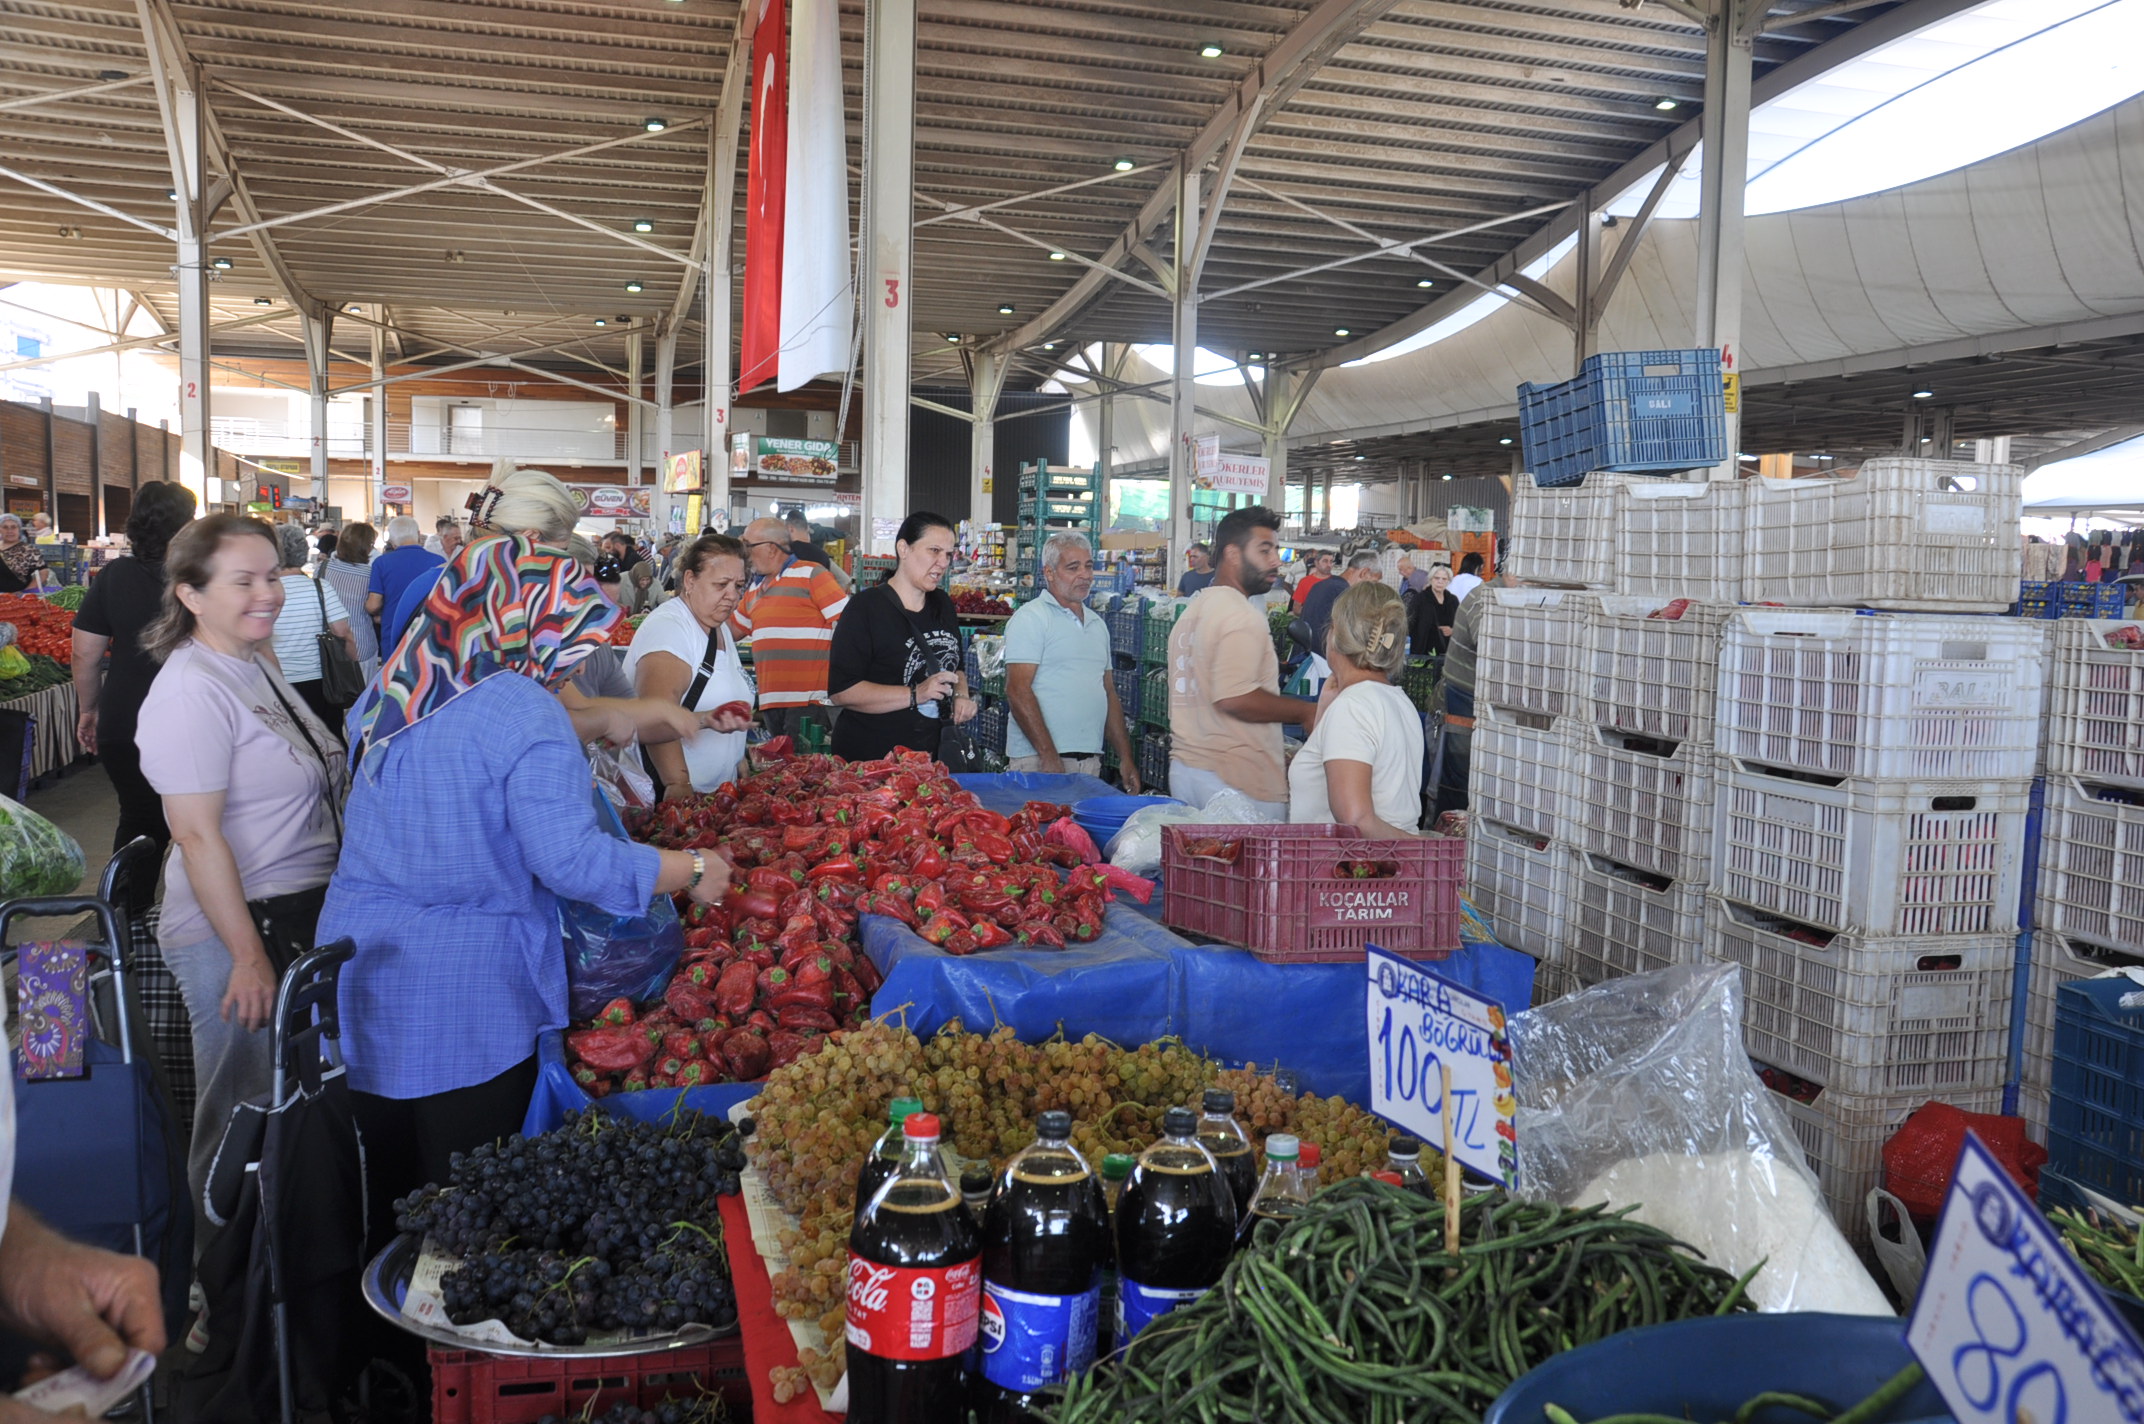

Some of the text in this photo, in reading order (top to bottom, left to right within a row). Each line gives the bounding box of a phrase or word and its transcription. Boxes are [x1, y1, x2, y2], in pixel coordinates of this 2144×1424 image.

[885, 279, 899, 307] 3
[1721, 344, 1733, 368] 4
[187, 382, 196, 398] 2
[717, 409, 724, 423] 3
[313, 436, 320, 447] 2
[766, 438, 832, 452] YENER GIDA
[984, 465, 990, 475] 4
[1279, 477, 1284, 486] 5
[1319, 892, 1409, 908] KOÇAKLAR
[1334, 908, 1393, 920] TARIM
[1378, 1006, 1485, 1149] 100 TL
[1951, 1271, 2068, 1424] 80
